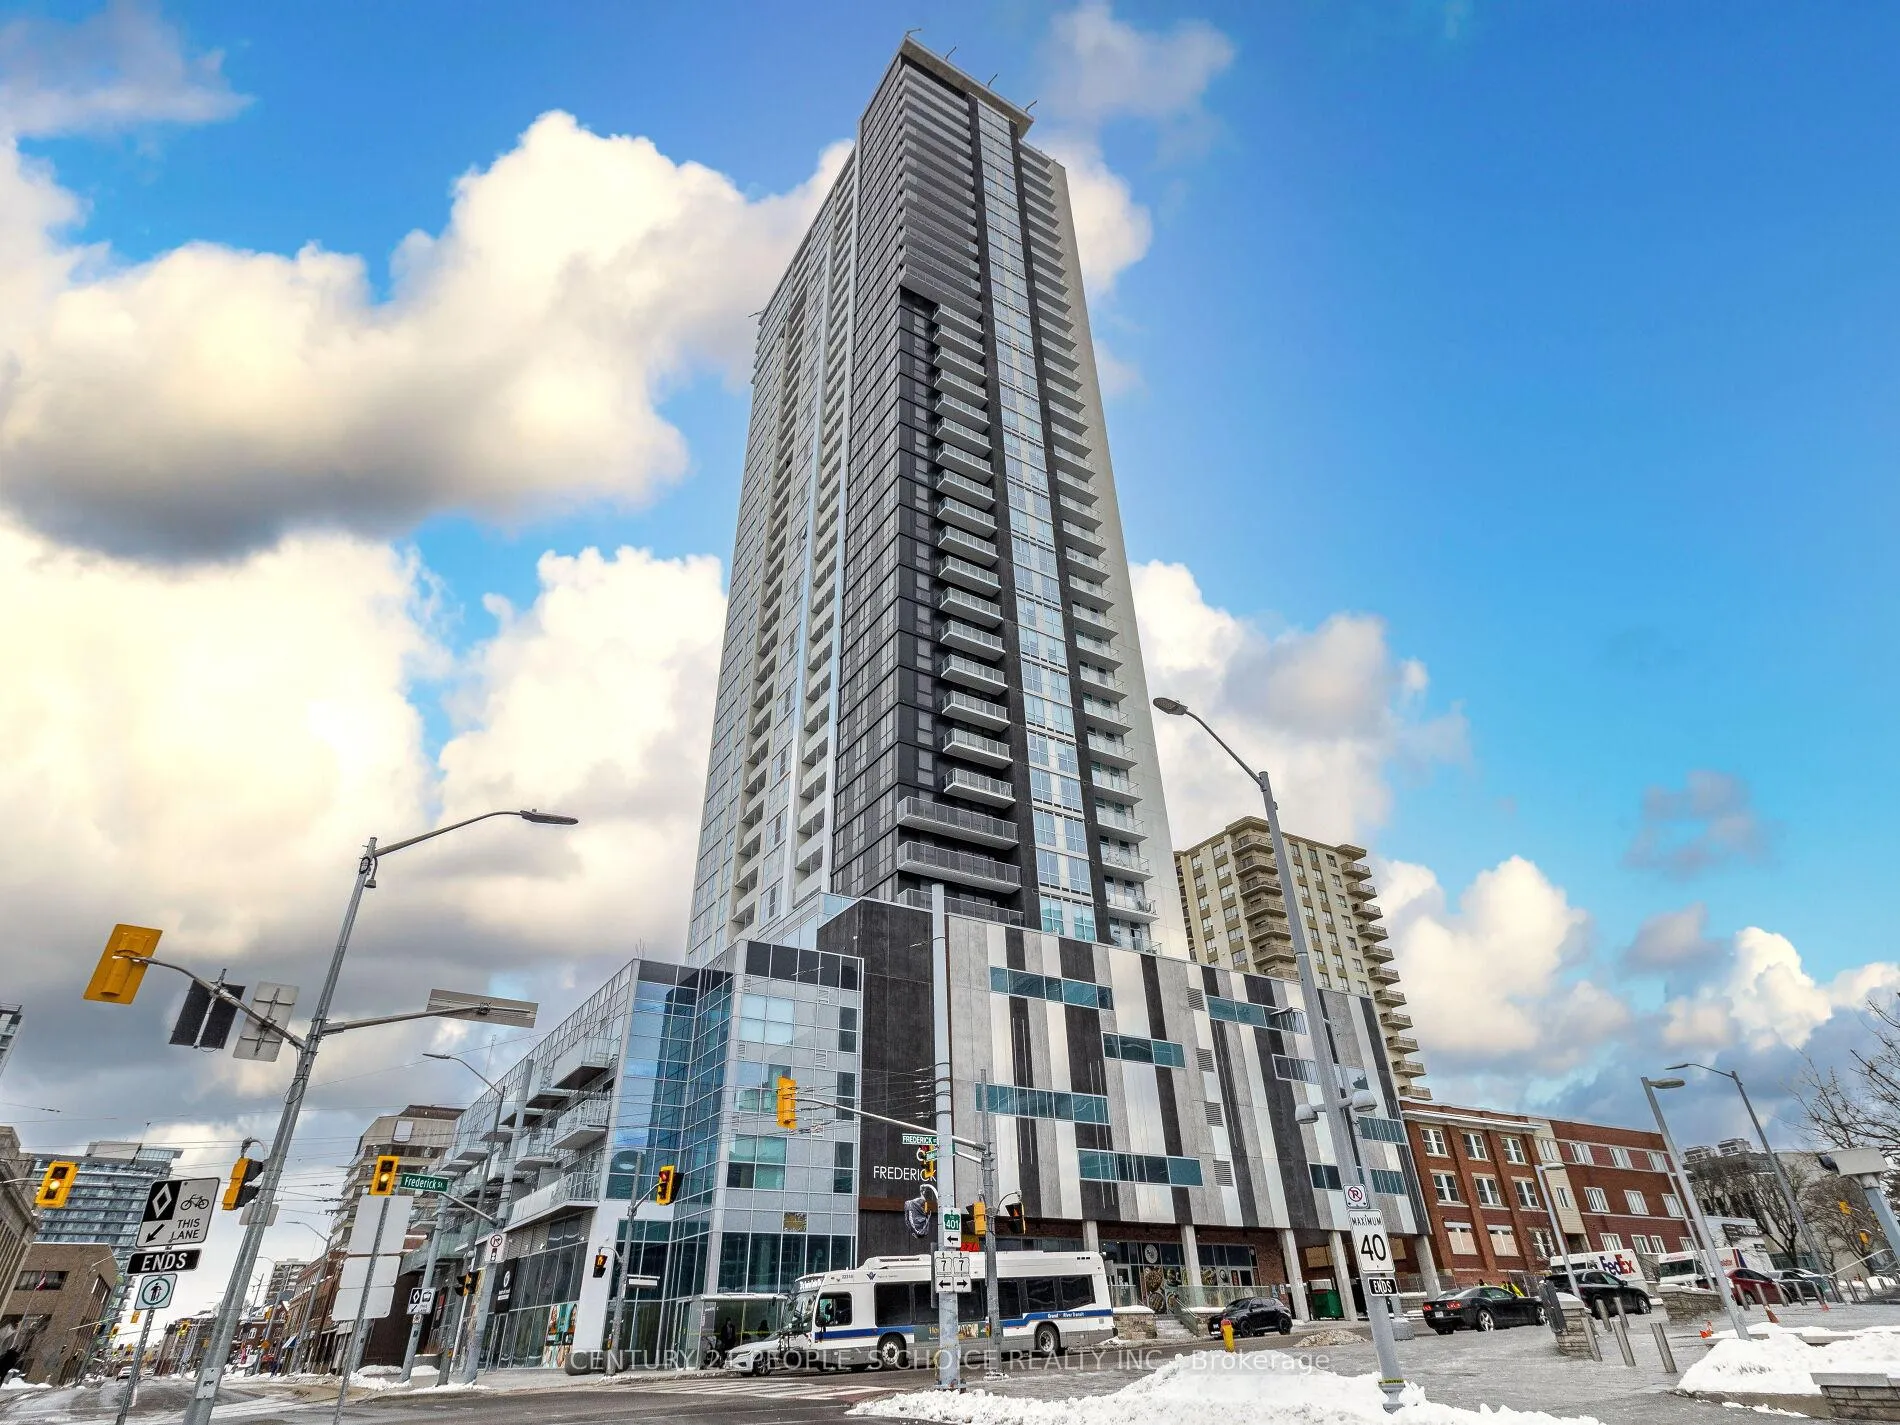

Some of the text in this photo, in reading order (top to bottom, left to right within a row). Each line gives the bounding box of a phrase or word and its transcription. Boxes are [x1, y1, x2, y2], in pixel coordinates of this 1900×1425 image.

[902, 1135, 933, 1144] FREDERICK
[873, 1166, 937, 1181] FREDERICK
[404, 1176, 437, 1189] Frederick
[177, 1218, 201, 1228] THIS
[945, 1220, 959, 1229] 401
[1352, 1217, 1382, 1226] MAXIMUM
[171, 1229, 200, 1240] LANE
[1361, 1234, 1386, 1261] 40
[141, 1252, 187, 1271] ENDS
[941, 1260, 947, 1271] 7
[959, 1260, 964, 1271] 7
[1599, 1254, 1636, 1275] FedEx
[1372, 1280, 1393, 1293] ENDS
